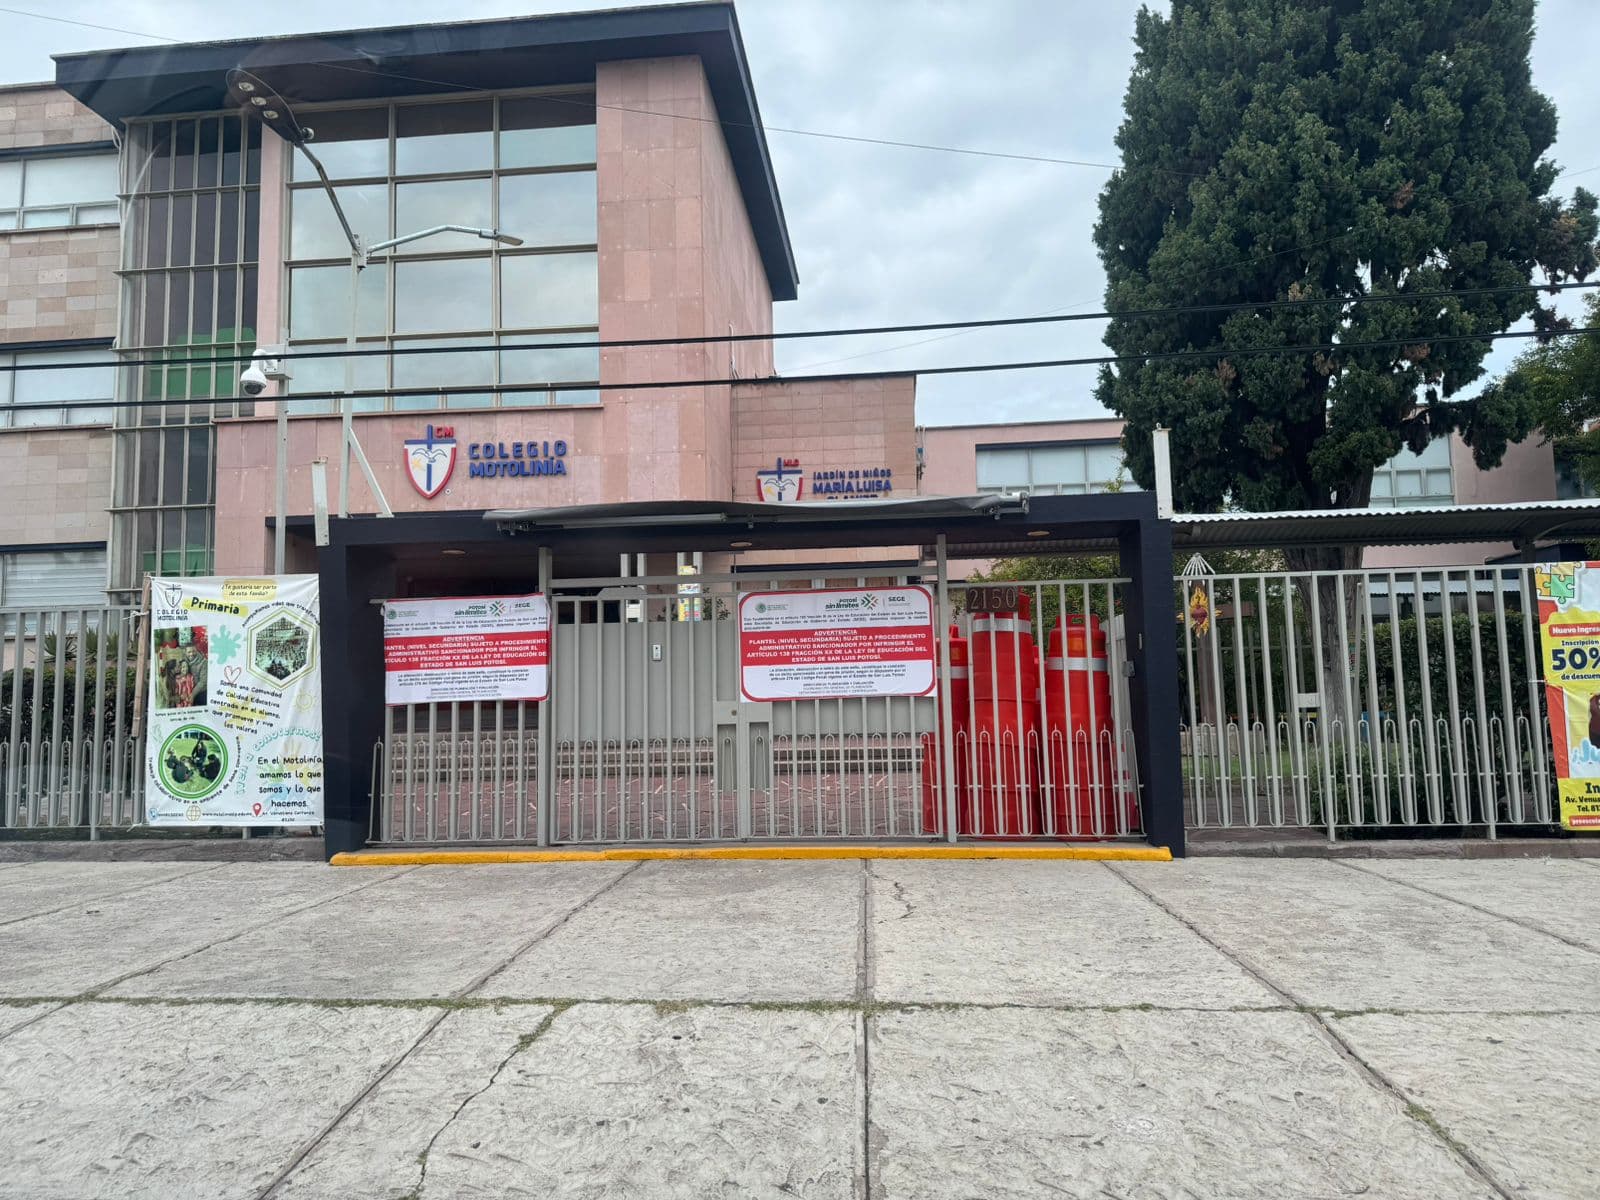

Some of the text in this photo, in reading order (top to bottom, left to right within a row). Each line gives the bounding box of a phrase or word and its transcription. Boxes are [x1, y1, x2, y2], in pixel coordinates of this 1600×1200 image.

[434, 427, 455, 439] CM
[468, 440, 568, 460] COLEGIO
[469, 456, 567, 478] MOTOLINÍA
[848, 470, 859, 479] DE
[812, 479, 892, 494] MARÍA LUISA
[970, 588, 1016, 610] 2150
[190, 596, 240, 615] Primaria
[1551, 626, 1577, 635] Nuevo
[875, 633, 927, 641] PROCEDIMIENTO
[791, 649, 823, 657] FRACCIÓN
[220, 680, 237, 689] Somos
[225, 691, 249, 701] Calidad
[224, 720, 258, 735] los valores
[257, 757, 269, 765] En
[271, 756, 280, 764] el
[259, 770, 322, 779] amamos lo que
[258, 784, 321, 794] somos y lo que
